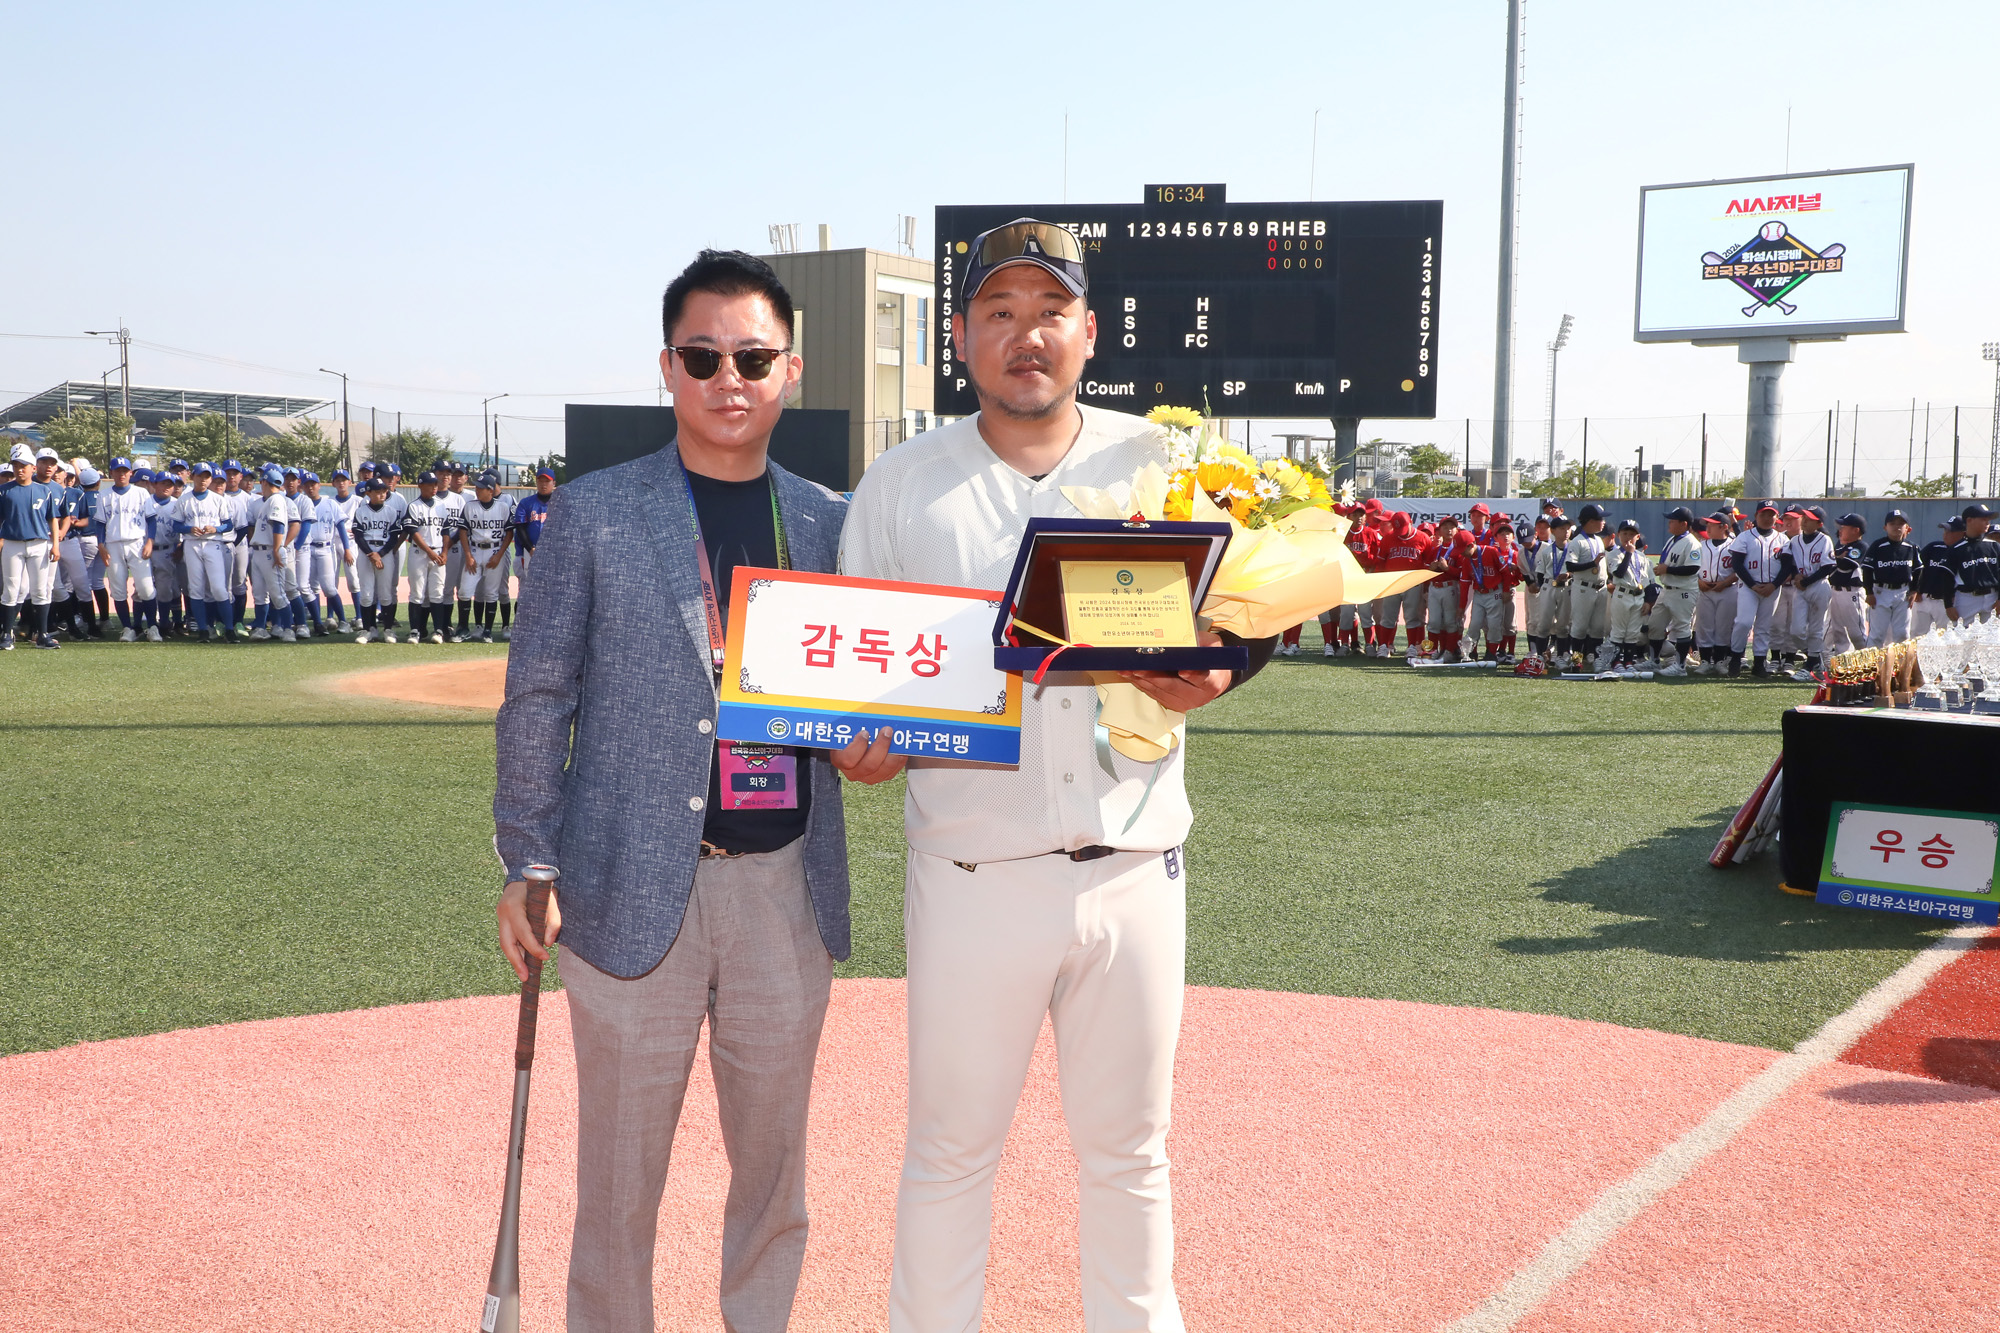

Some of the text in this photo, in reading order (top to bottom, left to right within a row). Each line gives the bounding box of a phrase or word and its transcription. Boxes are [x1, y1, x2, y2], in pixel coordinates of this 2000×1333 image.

[1156, 187, 1205, 202] 16:34
[1725, 193, 1821, 214] 시사저널
[944, 242, 952, 255] 1
[1424, 237, 1432, 251] 1
[1722, 243, 1741, 258] 2024
[1422, 253, 1432, 267] 2
[1741, 248, 1802, 263] 화성시장배
[943, 257, 952, 270] 2
[1704, 258, 1841, 278] 전국유소년야구대회
[943, 272, 952, 285] 3
[1422, 269, 1431, 282] 3
[1753, 276, 1792, 288] KYBF
[943, 287, 952, 300] 4
[1421, 285, 1431, 299] 4
[943, 302, 952, 316] 5
[1124, 297, 1137, 312] B
[1197, 297, 1209, 312] H
[1421, 301, 1430, 314] 5
[943, 318, 952, 331] 6
[1124, 316, 1136, 330] S
[1197, 316, 1208, 330] E
[1420, 317, 1430, 330] 6
[942, 333, 952, 346] 7
[1123, 334, 1136, 348] O
[1185, 334, 1208, 348] FC
[1419, 332, 1430, 346] 7
[942, 348, 952, 361] 8
[1419, 348, 1429, 361] 8
[942, 364, 952, 376] 9
[1419, 363, 1428, 377] 9
[956, 379, 967, 391] P
[1086, 381, 1135, 396] Count
[1222, 381, 1246, 396] SP
[1295, 382, 1325, 395] Km/h
[1340, 379, 1351, 392] P
[33, 498, 44, 510] J
[261, 523, 267, 531] 5
[470, 520, 504, 530] DAECHI
[492, 531, 502, 539] 22
[1519, 528, 1528, 537] W
[1670, 553, 1680, 564] W
[1811, 551, 1822, 564] W
[1877, 559, 1913, 568] Boryeong
[1962, 556, 1997, 569] Boryeong
[1748, 561, 1758, 569] 10
[1703, 570, 1707, 578] 3
[702, 580, 713, 602] KYBF
[800, 623, 948, 679] 감독상
[749, 776, 768, 788] 회장
[1870, 829, 1955, 869] 우승
[1856, 892, 1975, 919] 대한유소년야구연맹
